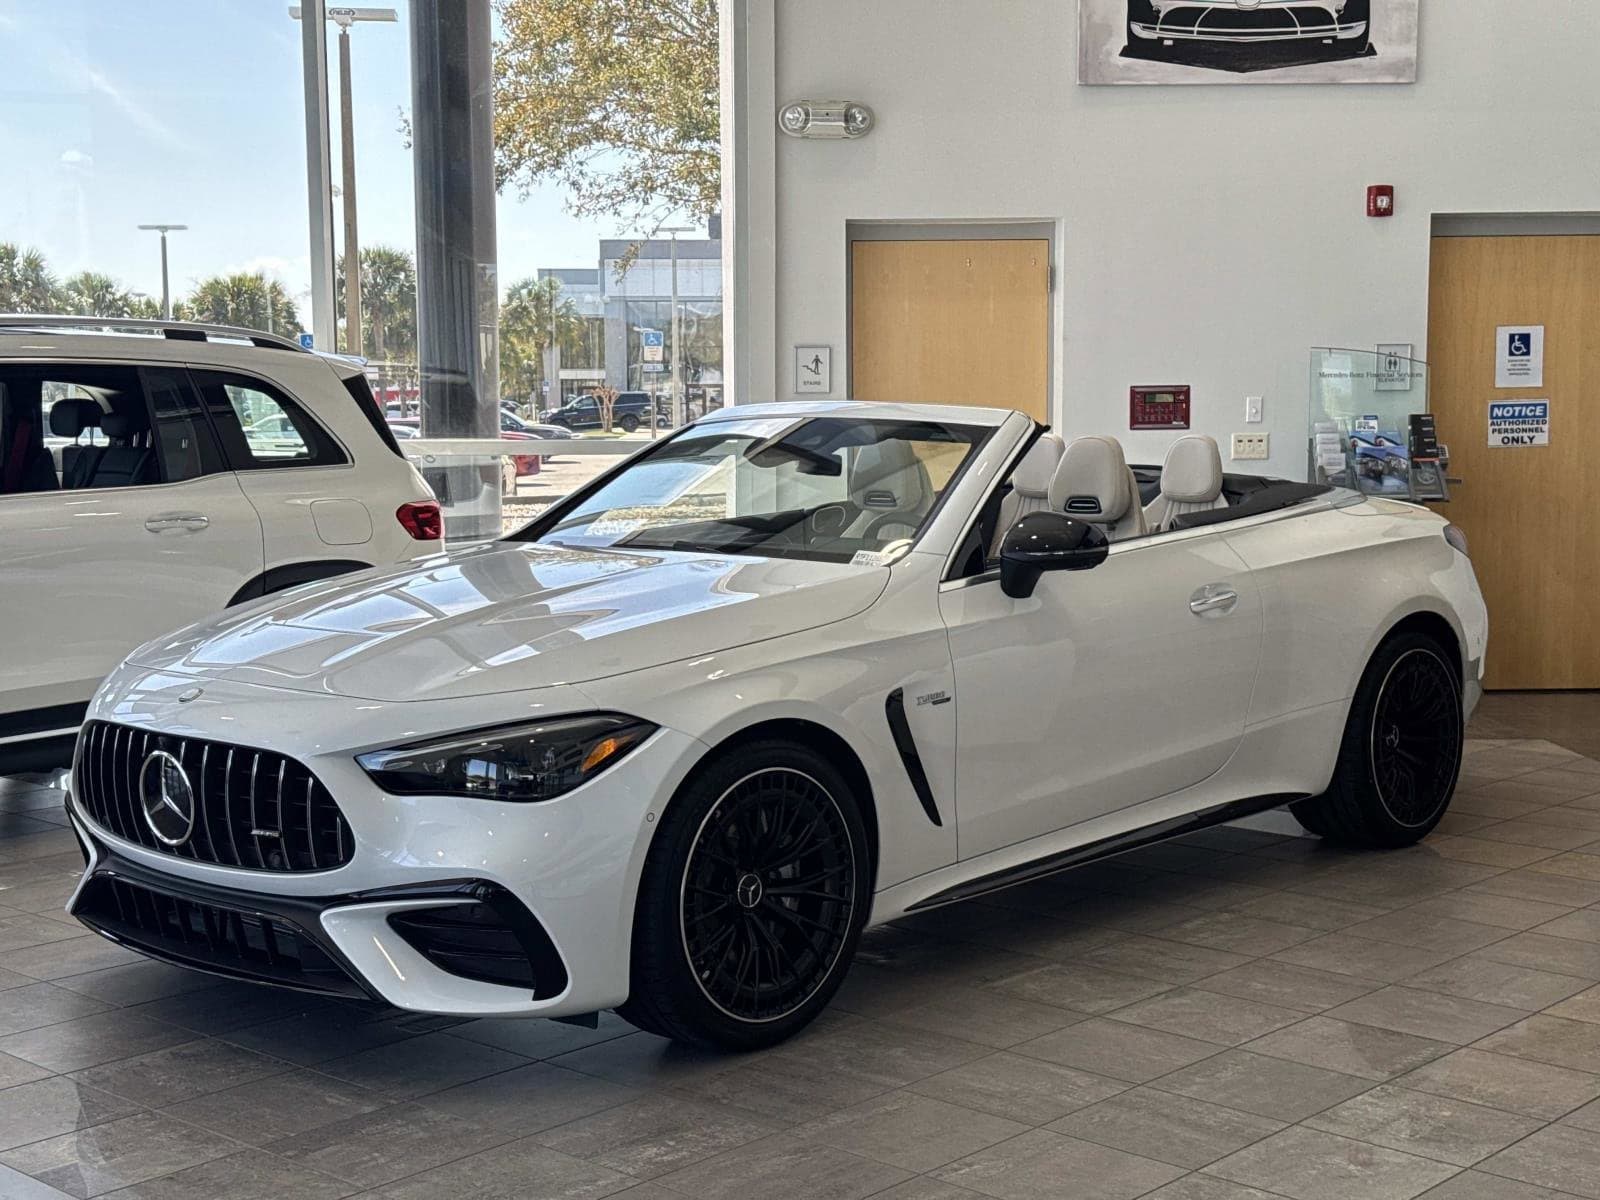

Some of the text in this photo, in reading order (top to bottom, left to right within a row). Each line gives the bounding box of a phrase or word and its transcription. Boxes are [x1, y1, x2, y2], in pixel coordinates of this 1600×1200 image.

[1366, 371, 1395, 379] Financial
[1397, 371, 1424, 379] Services
[1492, 405, 1545, 417] NOTICE
[1490, 418, 1547, 427] AUTHORIZED
[1491, 426, 1545, 435] PERSONNEL
[1501, 435, 1536, 445] ONLY
